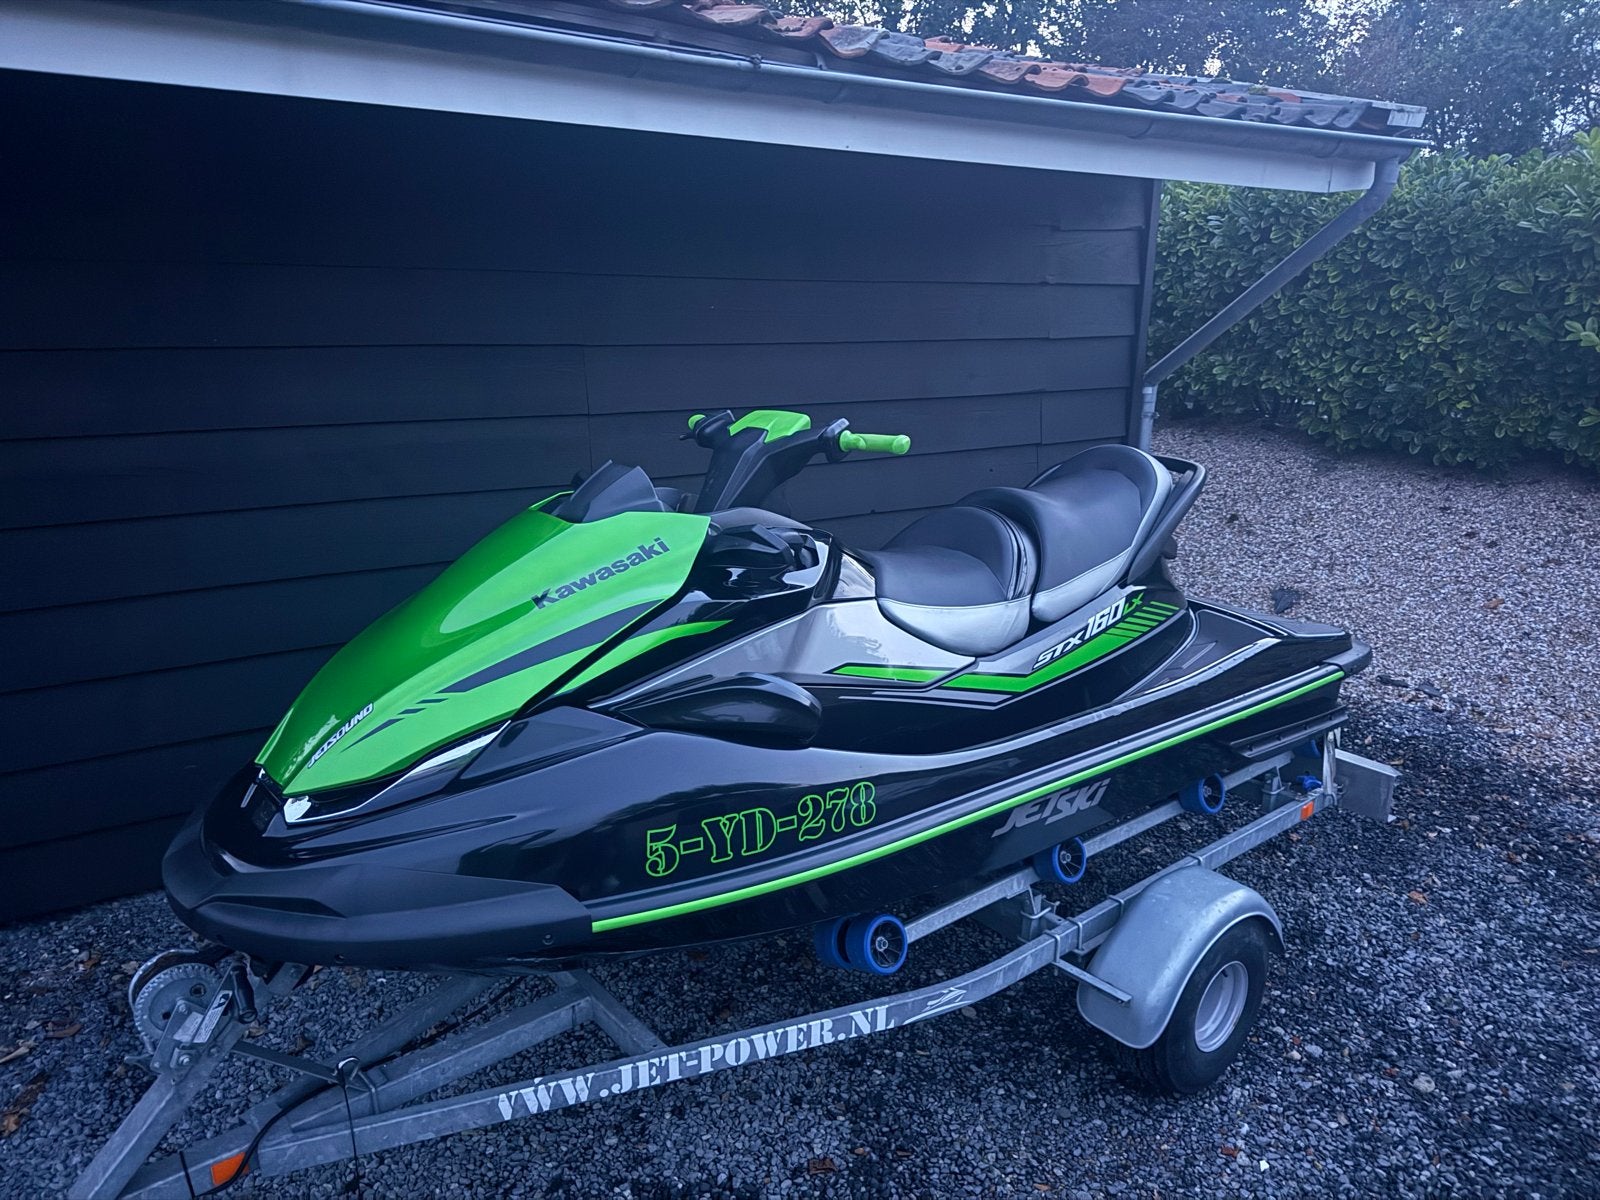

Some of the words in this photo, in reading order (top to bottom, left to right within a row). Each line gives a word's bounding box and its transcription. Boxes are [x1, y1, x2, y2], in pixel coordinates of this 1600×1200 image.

[531, 537, 670, 610] Kawasaki
[307, 703, 373, 769] JETSOUND
[645, 781, 876, 877] 5-YD-278
[498, 1005, 895, 1120] WWW.JET-POWER.NL
